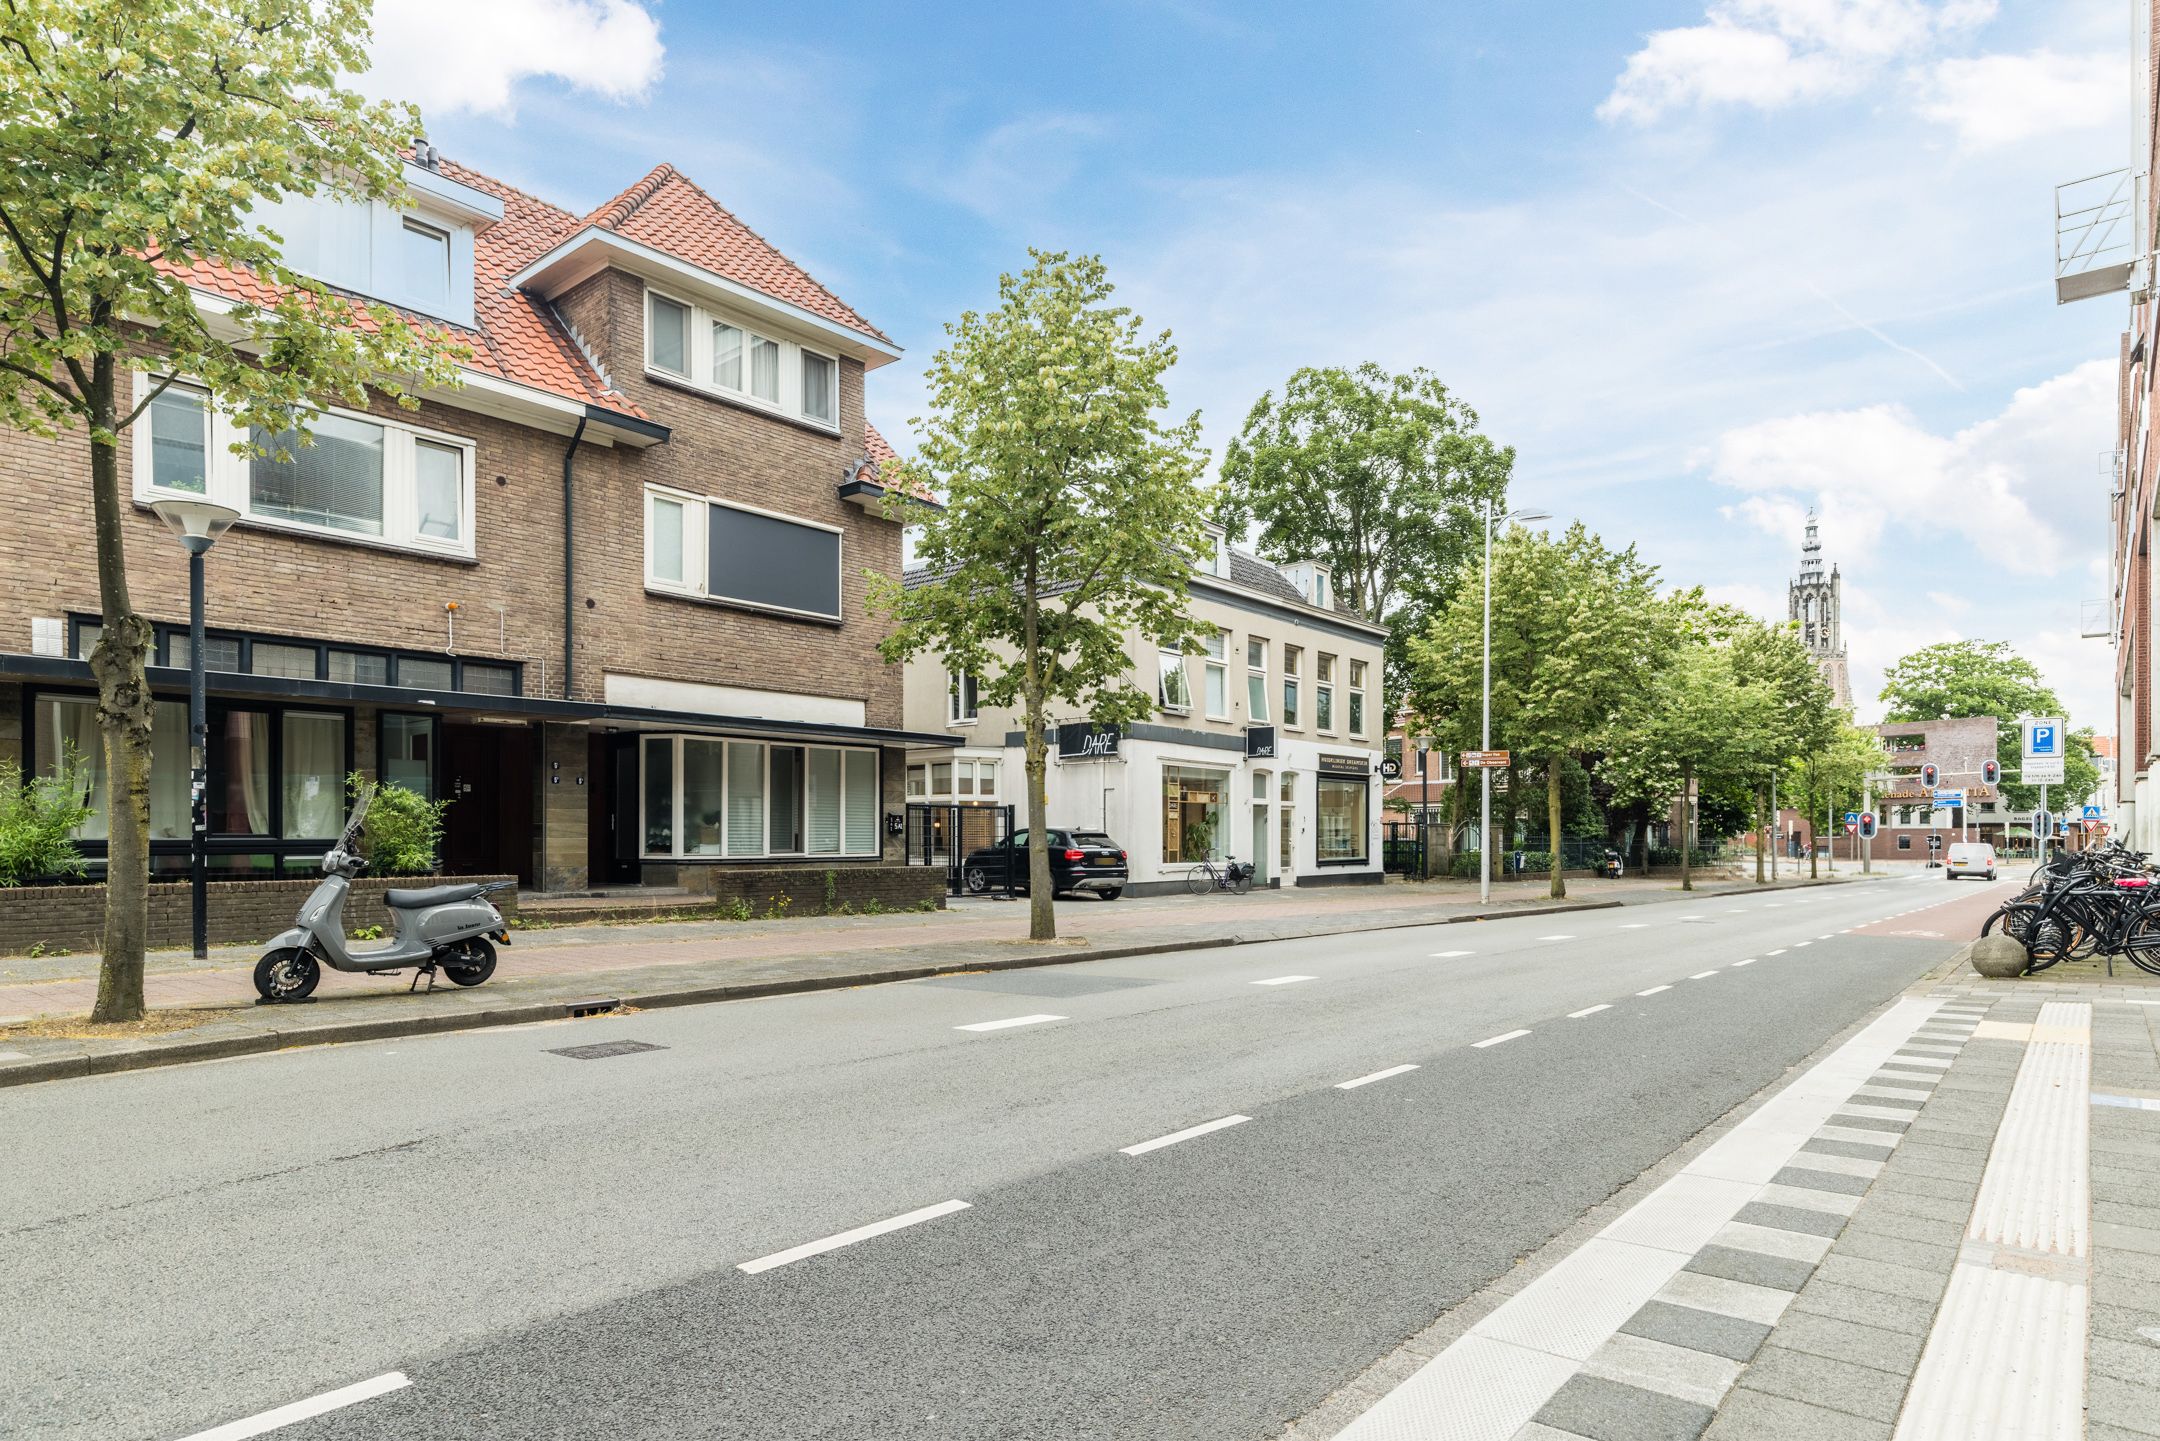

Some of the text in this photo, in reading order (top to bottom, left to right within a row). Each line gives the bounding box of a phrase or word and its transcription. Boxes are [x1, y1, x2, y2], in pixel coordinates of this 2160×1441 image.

[1082, 733, 1115, 753] DARE
[1256, 746, 1273, 756] DARE
[1382, 763, 1397, 773] HD
